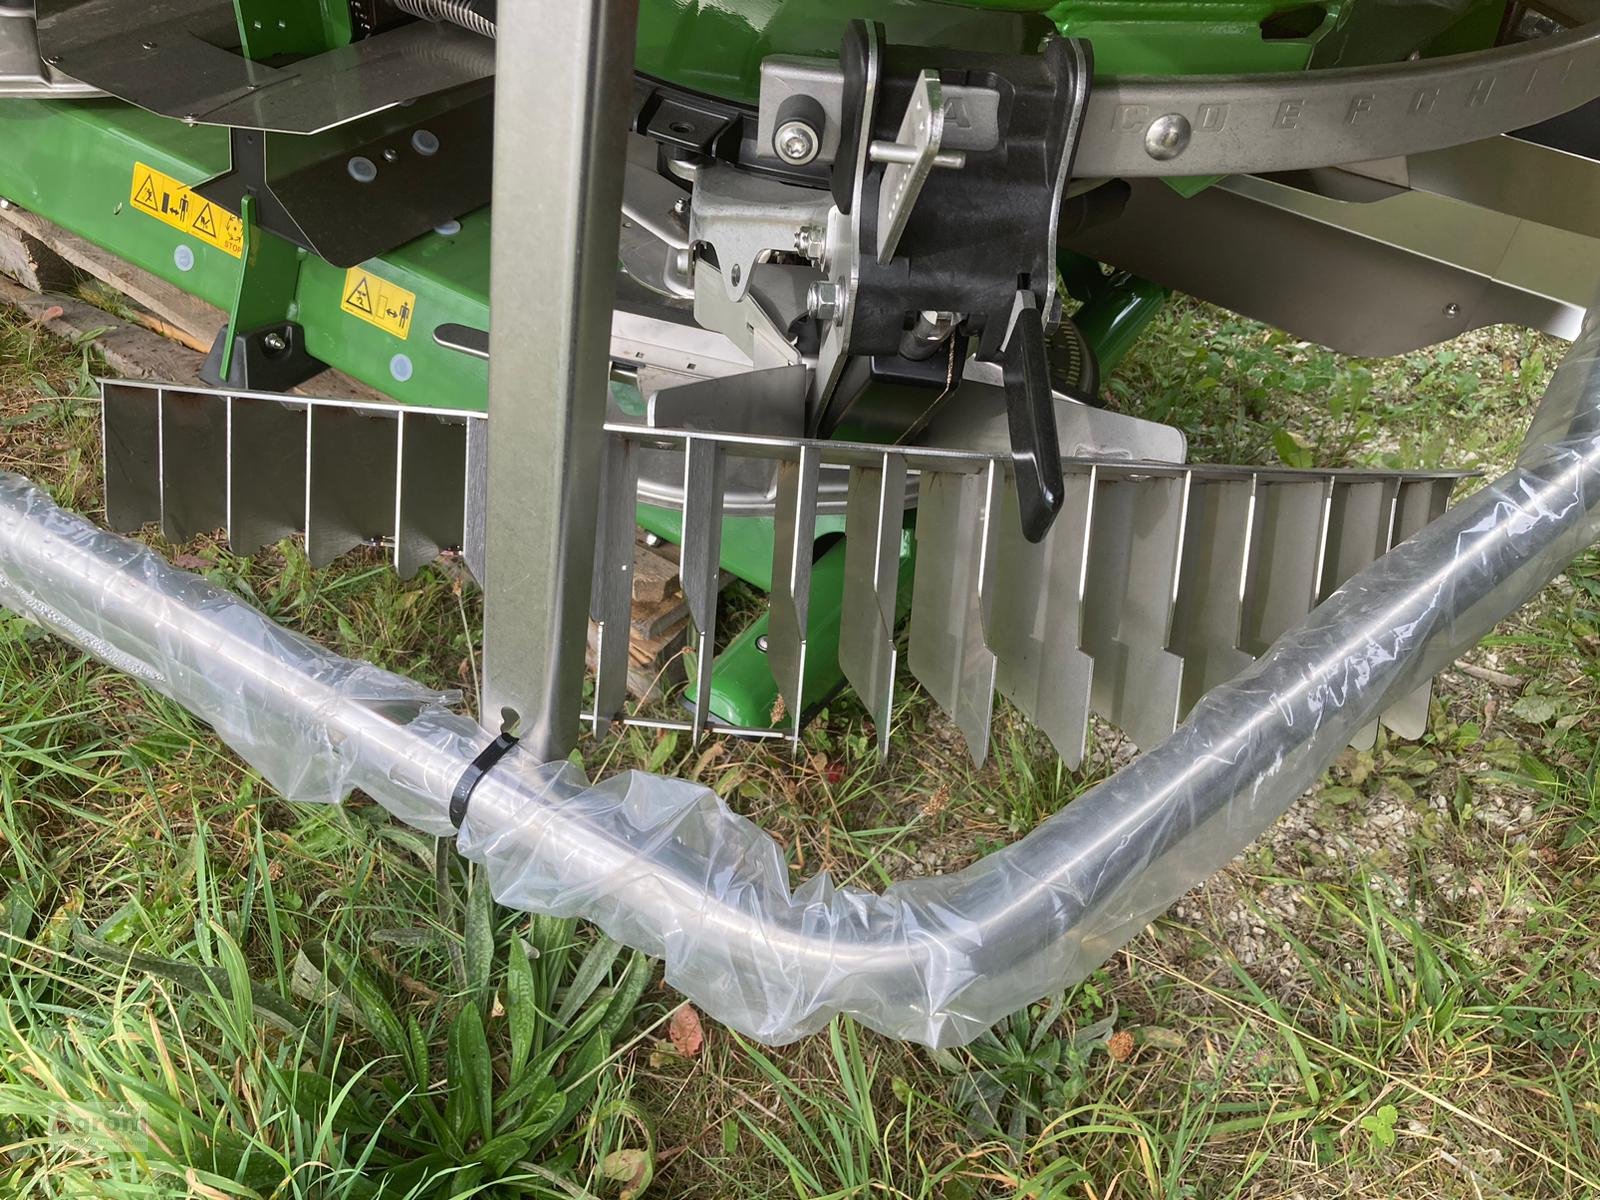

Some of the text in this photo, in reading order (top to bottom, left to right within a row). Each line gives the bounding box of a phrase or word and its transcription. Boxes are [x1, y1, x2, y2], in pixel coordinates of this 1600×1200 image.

[937, 86, 957, 108] A
[1111, 103, 1150, 133] C
[1192, 103, 1231, 134] D
[1272, 99, 1306, 130] E
[1344, 93, 1376, 126] F
[1466, 78, 1501, 107] H
[224, 240, 242, 254] STOP
